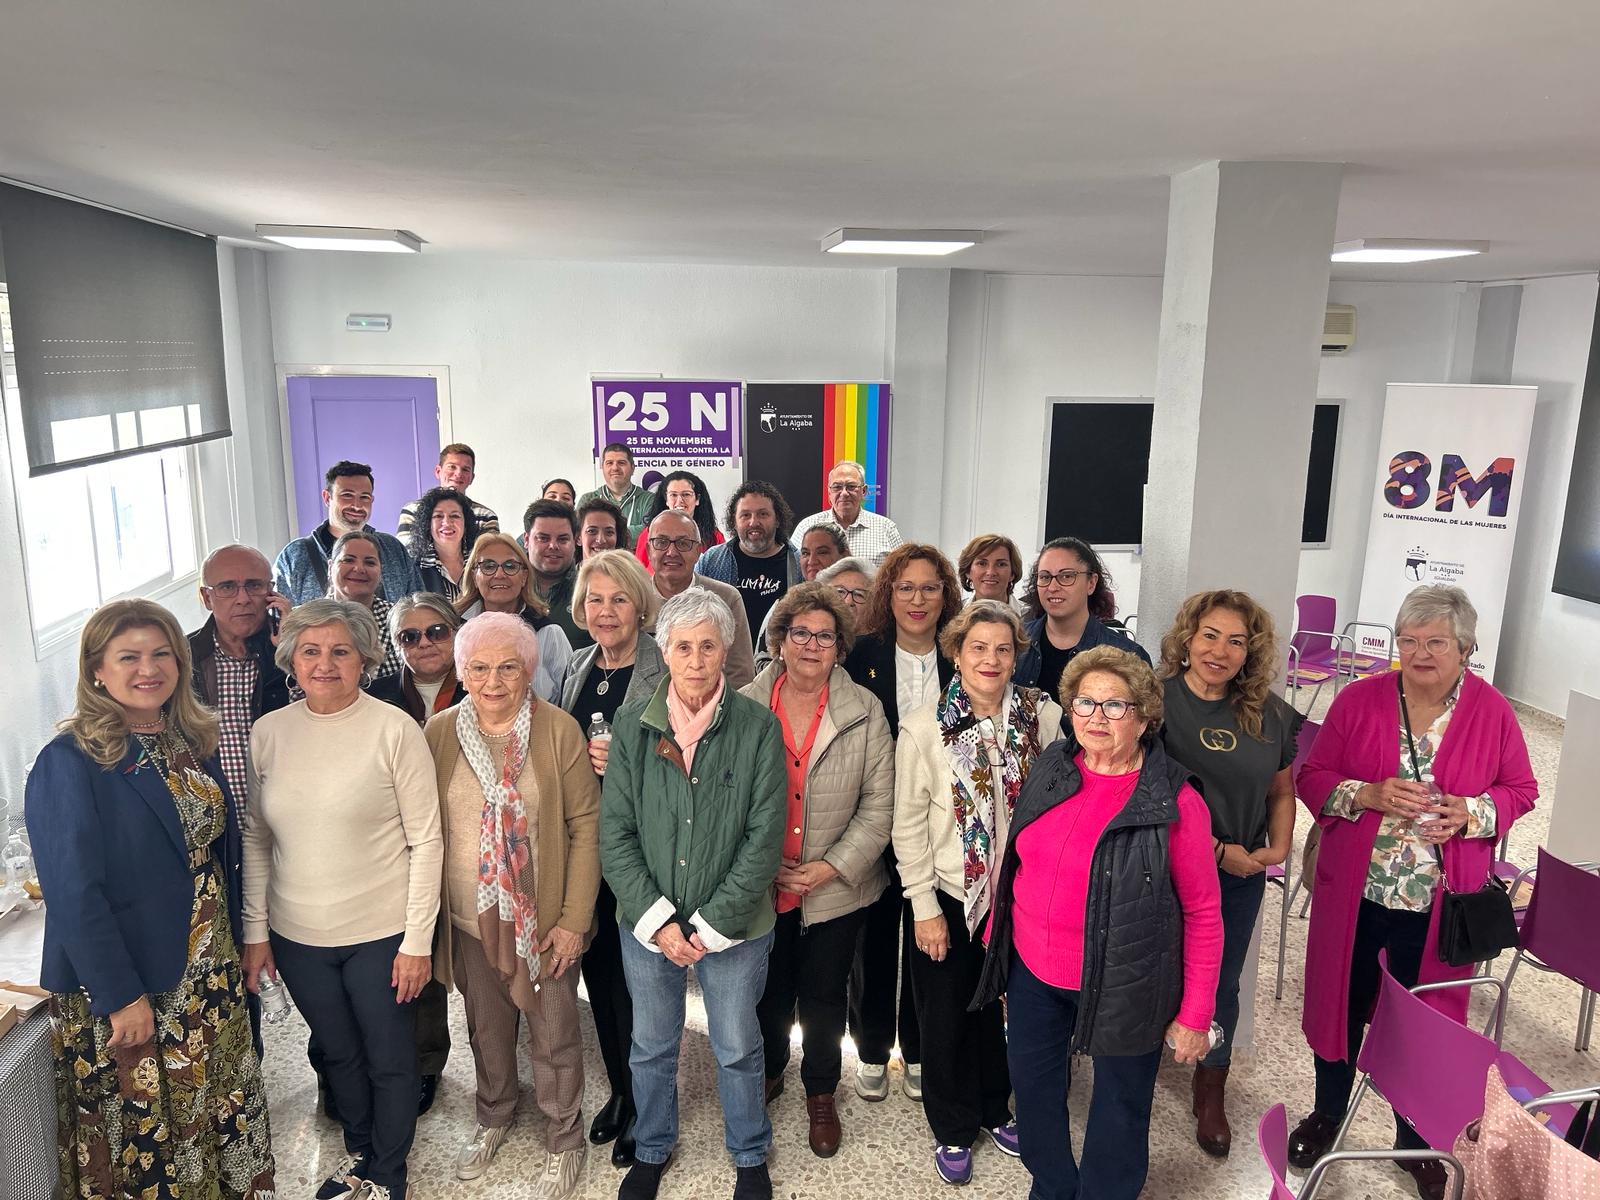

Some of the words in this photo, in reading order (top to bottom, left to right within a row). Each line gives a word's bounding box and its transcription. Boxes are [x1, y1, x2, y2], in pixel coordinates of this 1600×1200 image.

[607, 391, 669, 431] 25
[690, 392, 727, 431] N
[789, 419, 813, 427] Algaba
[656, 437, 713, 445] NOVIEMBRE
[686, 457, 725, 467] GÉNERO
[1384, 451, 1515, 517] 8M
[1395, 513, 1448, 524] INTERNACIONAL
[1474, 521, 1507, 529] MUJERES
[1439, 566, 1464, 575] Algaba
[1362, 636, 1385, 648] CMIM
